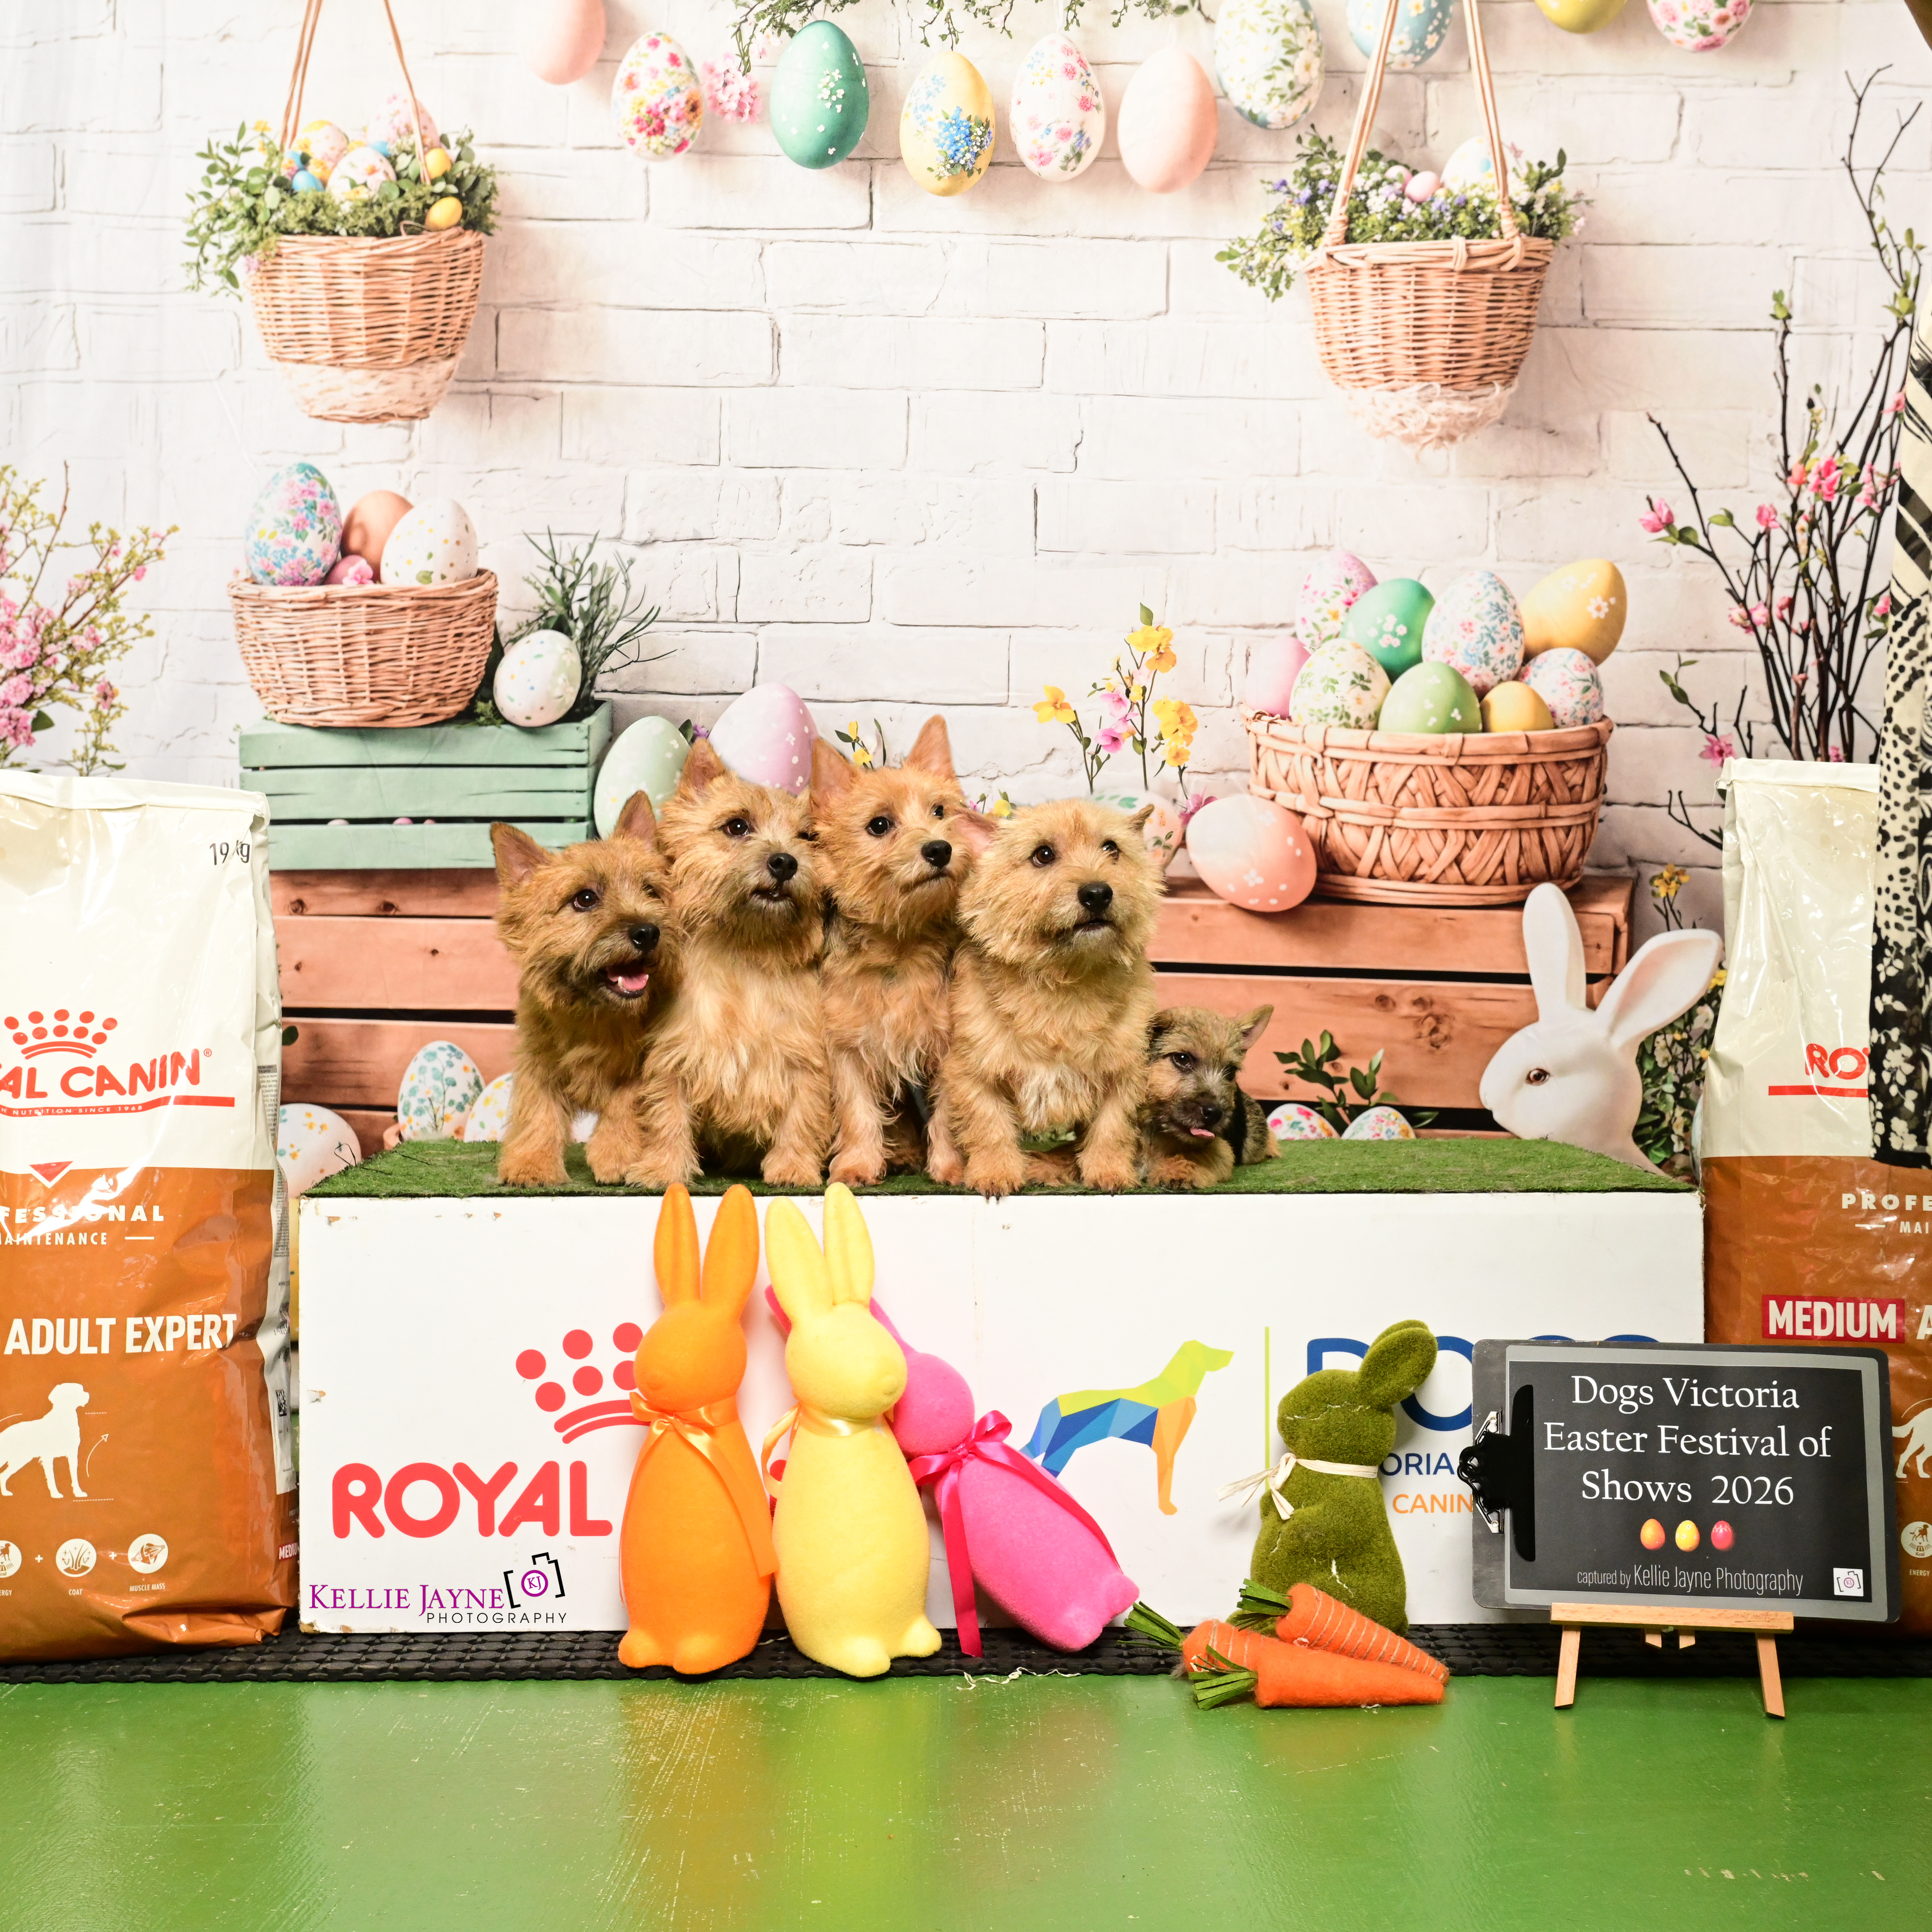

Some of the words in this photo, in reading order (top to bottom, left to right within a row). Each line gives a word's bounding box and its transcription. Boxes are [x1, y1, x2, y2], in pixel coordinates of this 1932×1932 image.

[210, 842, 229, 866] 19
[235, 840, 250, 864] kg
[1805, 1043, 1869, 1080] RO
[0, 1063, 48, 1099] AL
[0, 1205, 164, 1223] FESSONAL
[1842, 1193, 1932, 1211] PROFE
[0, 1232, 107, 1245] AINTENANCE
[4, 1318, 116, 1355] ADULT
[126, 1313, 237, 1353] EXPERT
[1769, 1300, 1897, 1339] MEDIUM
[1571, 1375, 1654, 1414] Dogs
[1662, 1378, 1800, 1409] Victoria
[1544, 1422, 1648, 1453] Easter
[1658, 1425, 1790, 1457] Festival
[1799, 1426, 1832, 1458] of
[332, 1461, 613, 1539] ROYAL
[1582, 1468, 1692, 1503] Shows
[1711, 1475, 1793, 1505] 2026
[279, 1542, 299, 1560] MEDIU
[1577, 1570, 1617, 1587] captured
[1620, 1570, 1631, 1589] by
[1634, 1564, 1669, 1587] Kellie
[1674, 1566, 1711, 1593] Jayne
[1716, 1567, 1804, 1596] Photography
